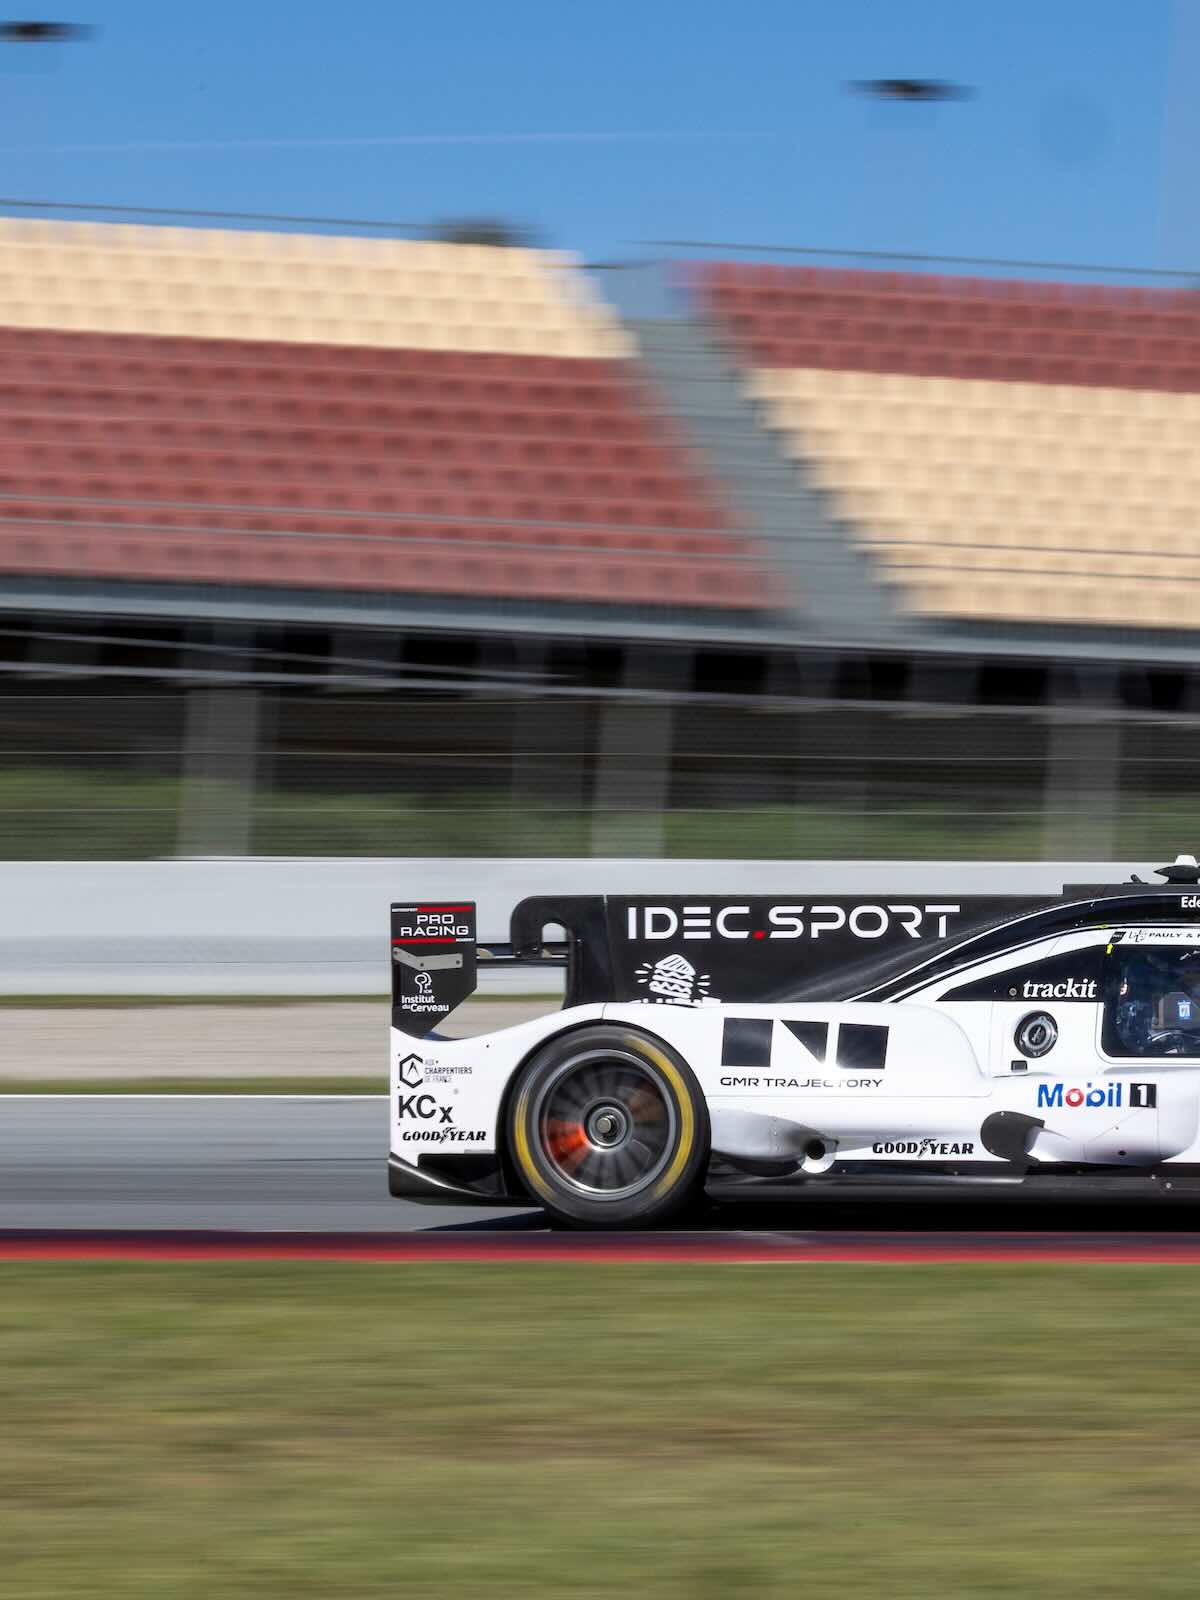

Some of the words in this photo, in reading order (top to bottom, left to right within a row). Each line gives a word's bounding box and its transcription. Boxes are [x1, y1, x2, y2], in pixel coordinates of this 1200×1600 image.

[416, 914, 454, 924] PRO
[400, 926, 469, 937] RACING
[1023, 978, 1098, 998] trackit
[401, 995, 435, 1004] Institut
[410, 1003, 449, 1012] Cerveau
[424, 1066, 472, 1075] CHARPENTIERS
[720, 1077, 760, 1087] GMR
[1037, 1082, 1122, 1108] Mobil
